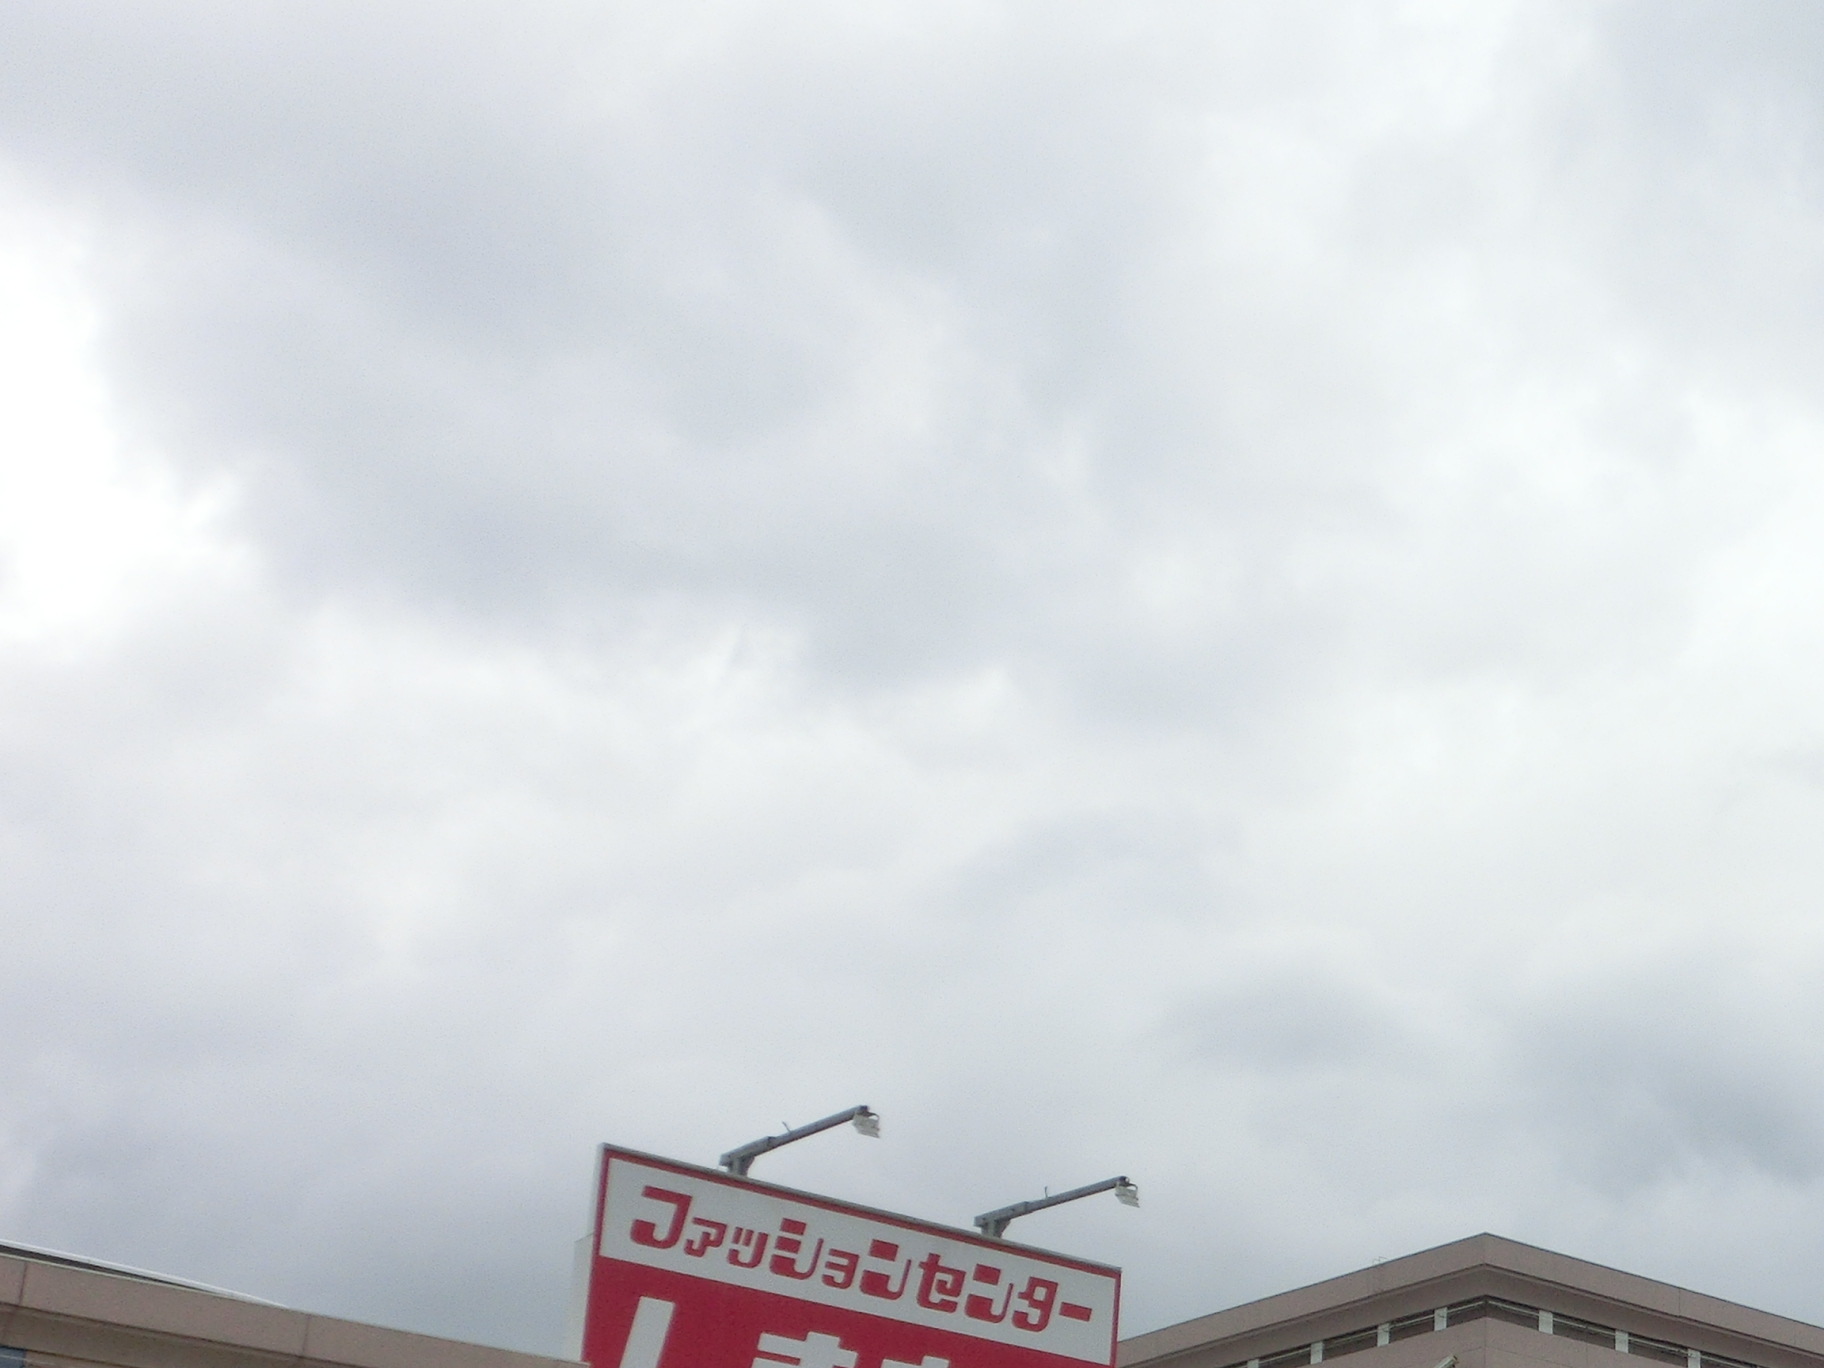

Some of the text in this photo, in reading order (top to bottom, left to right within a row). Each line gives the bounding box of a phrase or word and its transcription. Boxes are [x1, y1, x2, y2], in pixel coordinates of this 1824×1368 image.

[629, 1186, 1093, 1332] ファッションセンター
